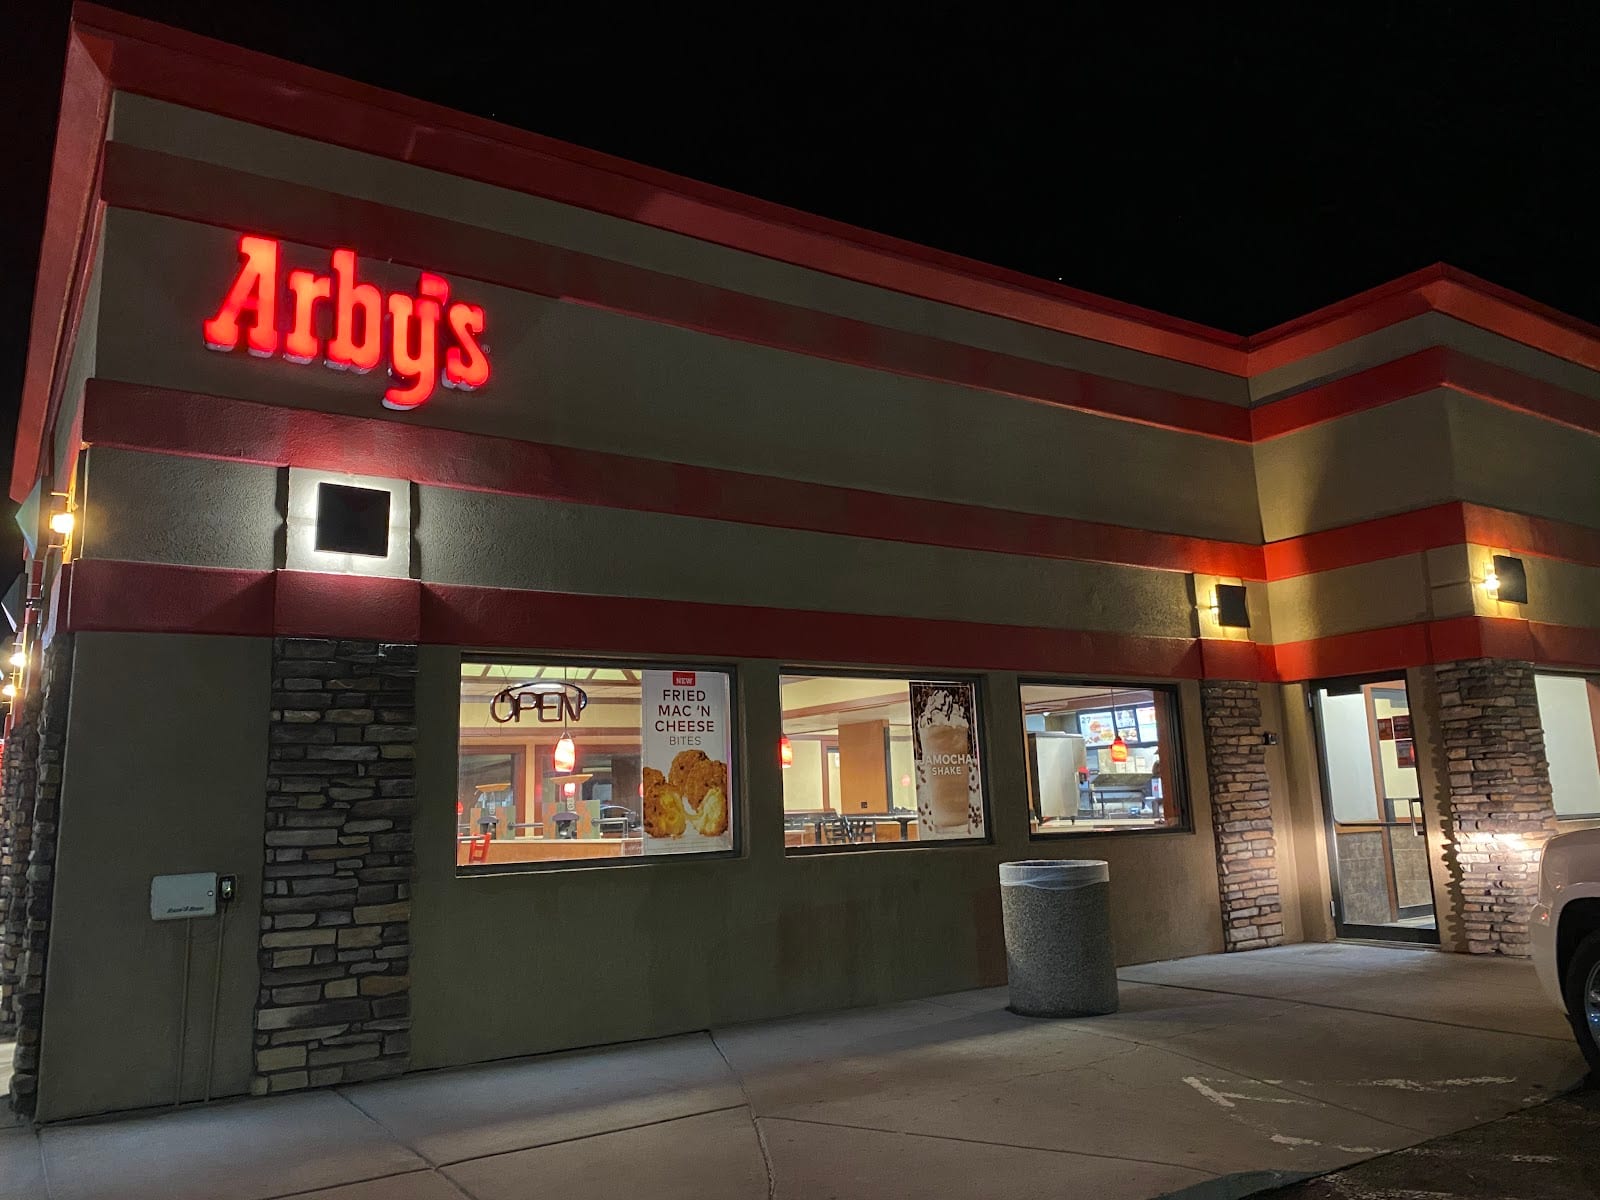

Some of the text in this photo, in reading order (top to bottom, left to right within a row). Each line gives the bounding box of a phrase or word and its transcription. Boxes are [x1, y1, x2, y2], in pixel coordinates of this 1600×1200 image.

[203, 235, 491, 406] Arby's
[663, 689, 706, 702] FRIED
[490, 690, 581, 723] OPEN
[658, 704, 692, 717] MAC
[655, 720, 714, 733] CHEESE
[669, 736, 702, 746] BITES
[920, 753, 973, 766] JAMOCHA
[932, 766, 962, 776] SHAKE
